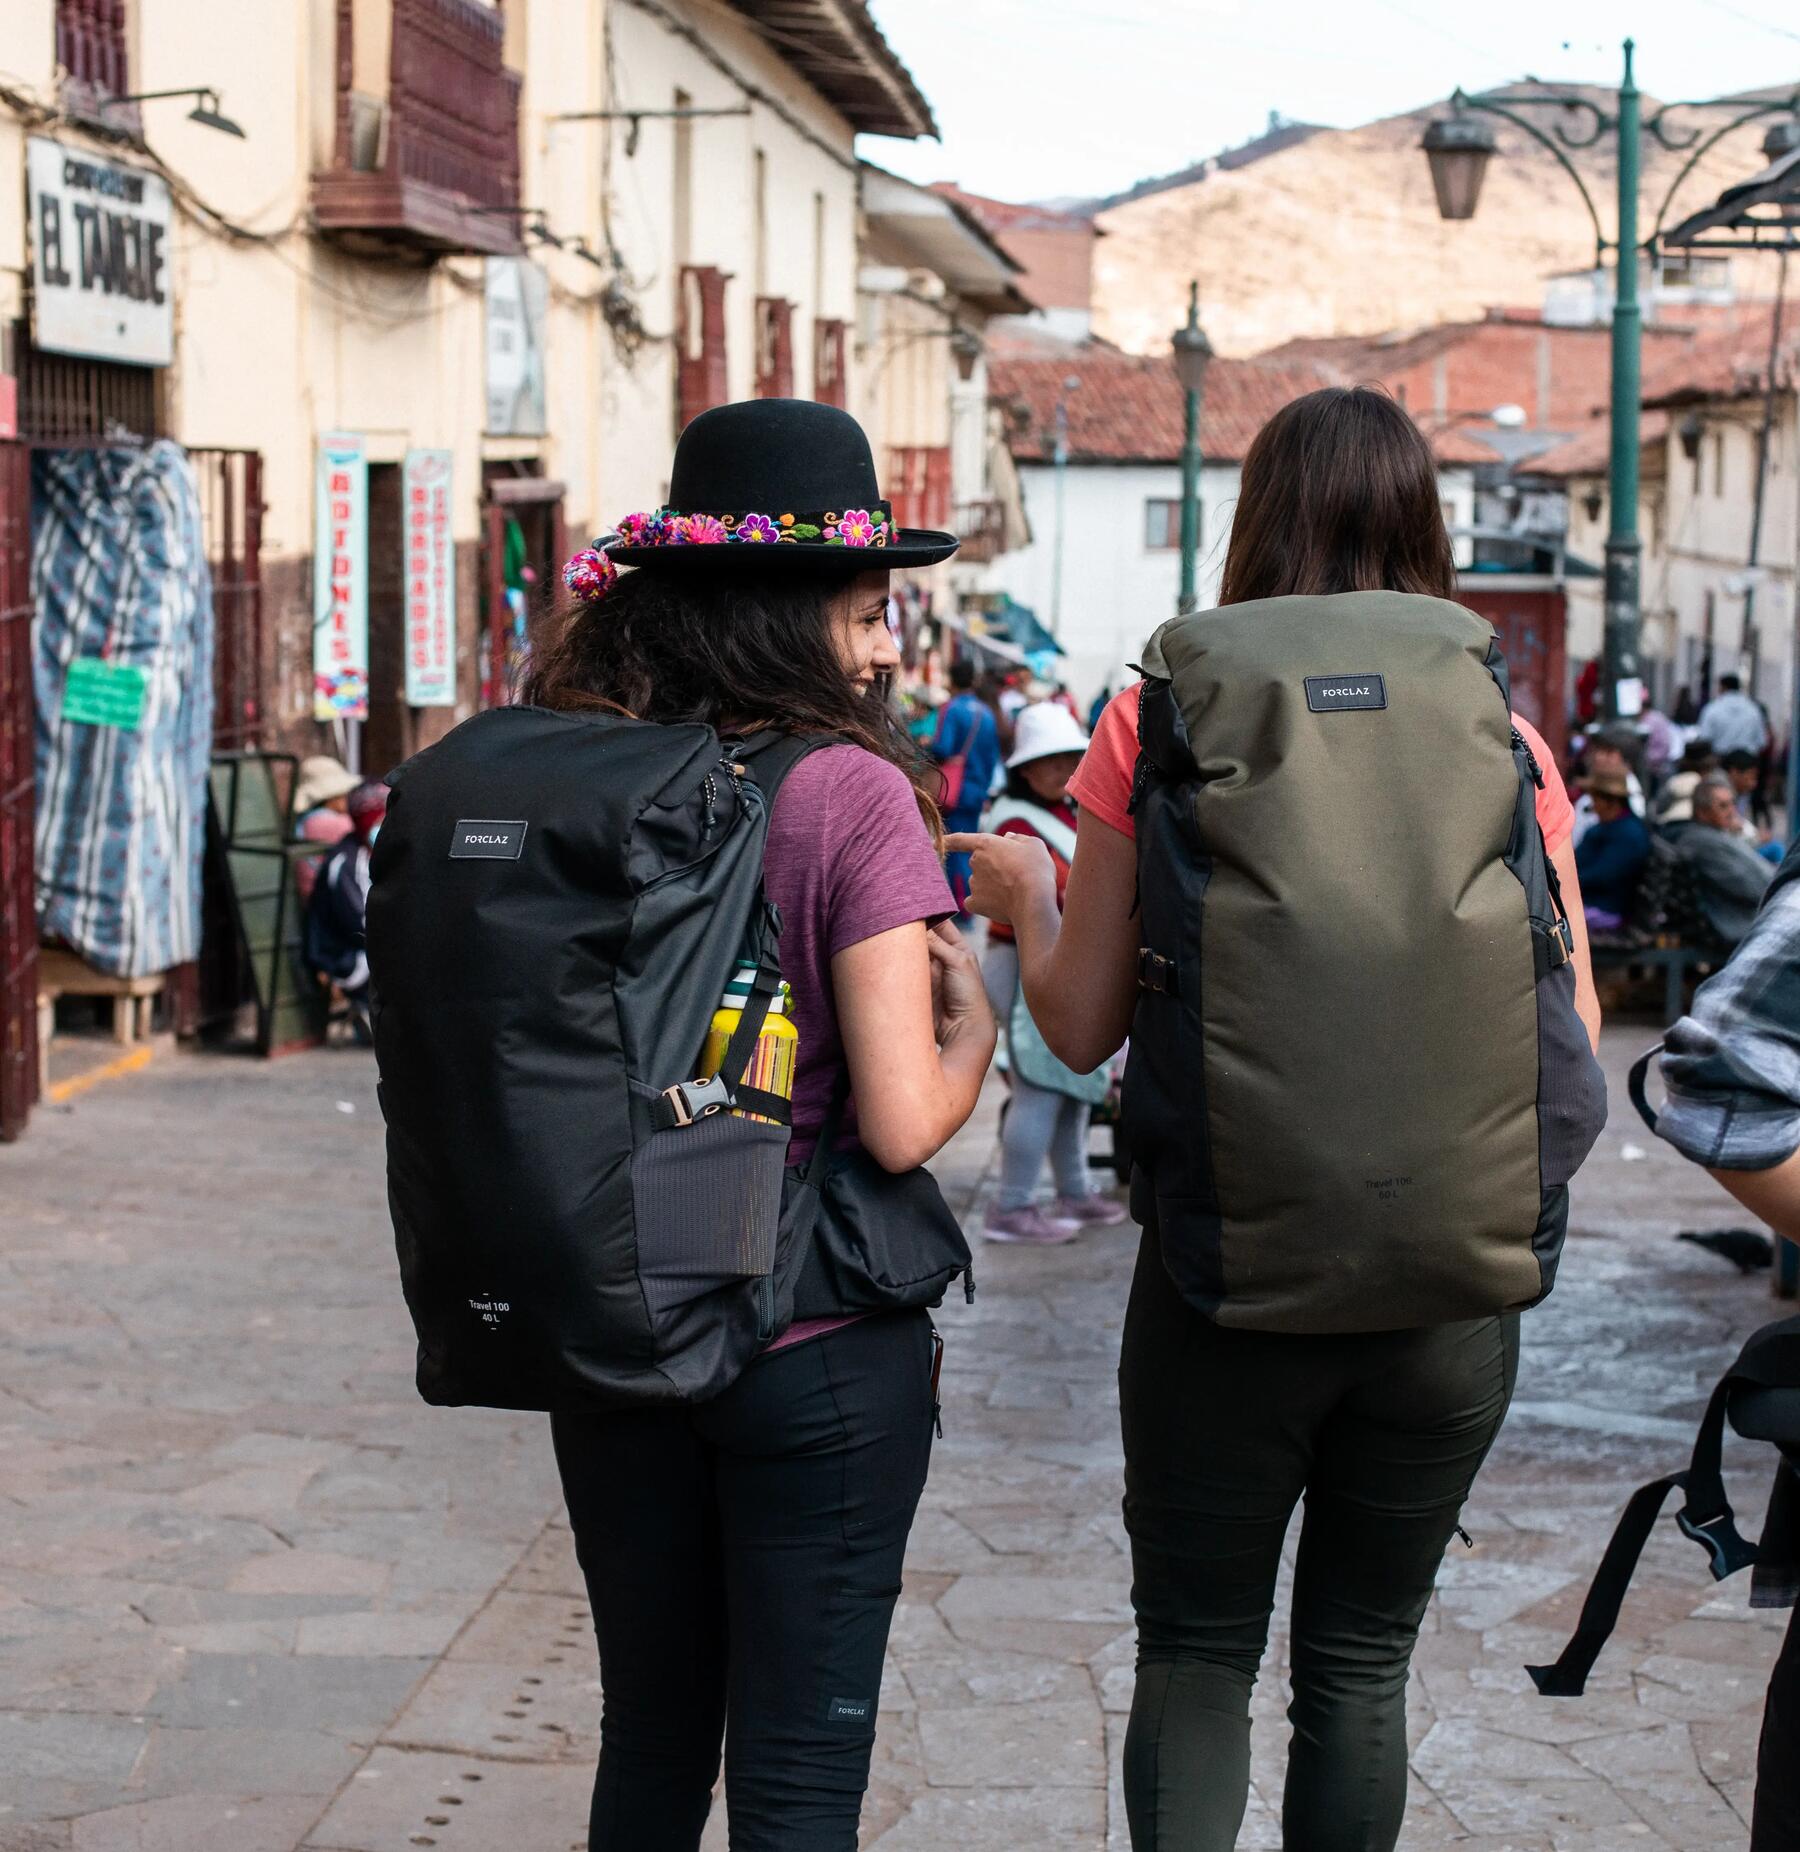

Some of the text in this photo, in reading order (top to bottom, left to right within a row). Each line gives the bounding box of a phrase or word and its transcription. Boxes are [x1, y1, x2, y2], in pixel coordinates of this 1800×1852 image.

[40, 192, 70, 287] EL
[330, 472, 351, 661] BOTONES
[1322, 687, 1370, 697] FORCLAZ
[464, 835, 509, 844] FORCLAZ
[1393, 1190, 1399, 1198] L
[468, 1299, 510, 1311] Travel 100
[482, 1313, 501, 1322] 40 L
[838, 1707, 865, 1715] FORCLAZ
